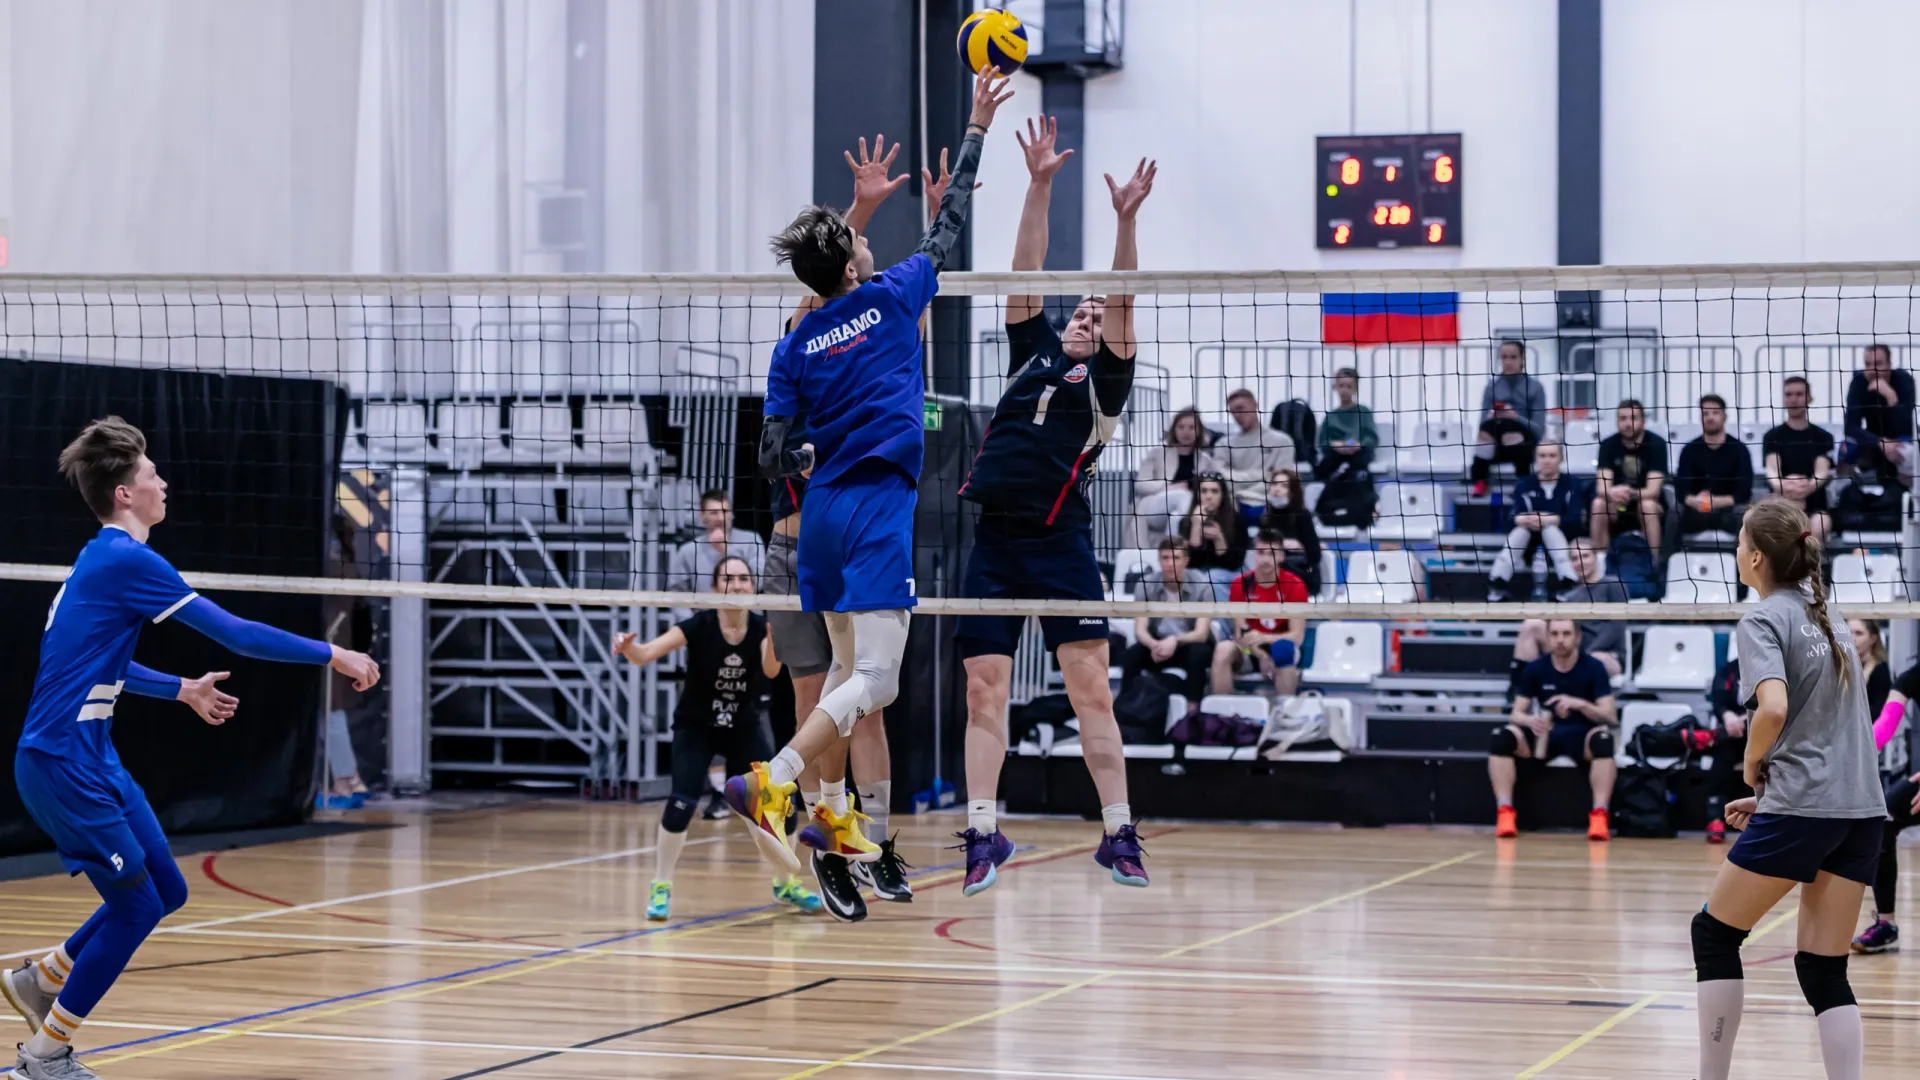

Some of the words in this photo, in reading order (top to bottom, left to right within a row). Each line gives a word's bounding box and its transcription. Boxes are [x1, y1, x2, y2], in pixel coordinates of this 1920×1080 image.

[1434, 154, 1453, 183] 6
[805, 308, 882, 355] ДИНАМО
[1032, 384, 1058, 426] 1
[718, 667, 746, 679] KEEP
[714, 680, 747, 692] CALM
[711, 699, 740, 712] PLAY
[110, 852, 124, 872] 5
